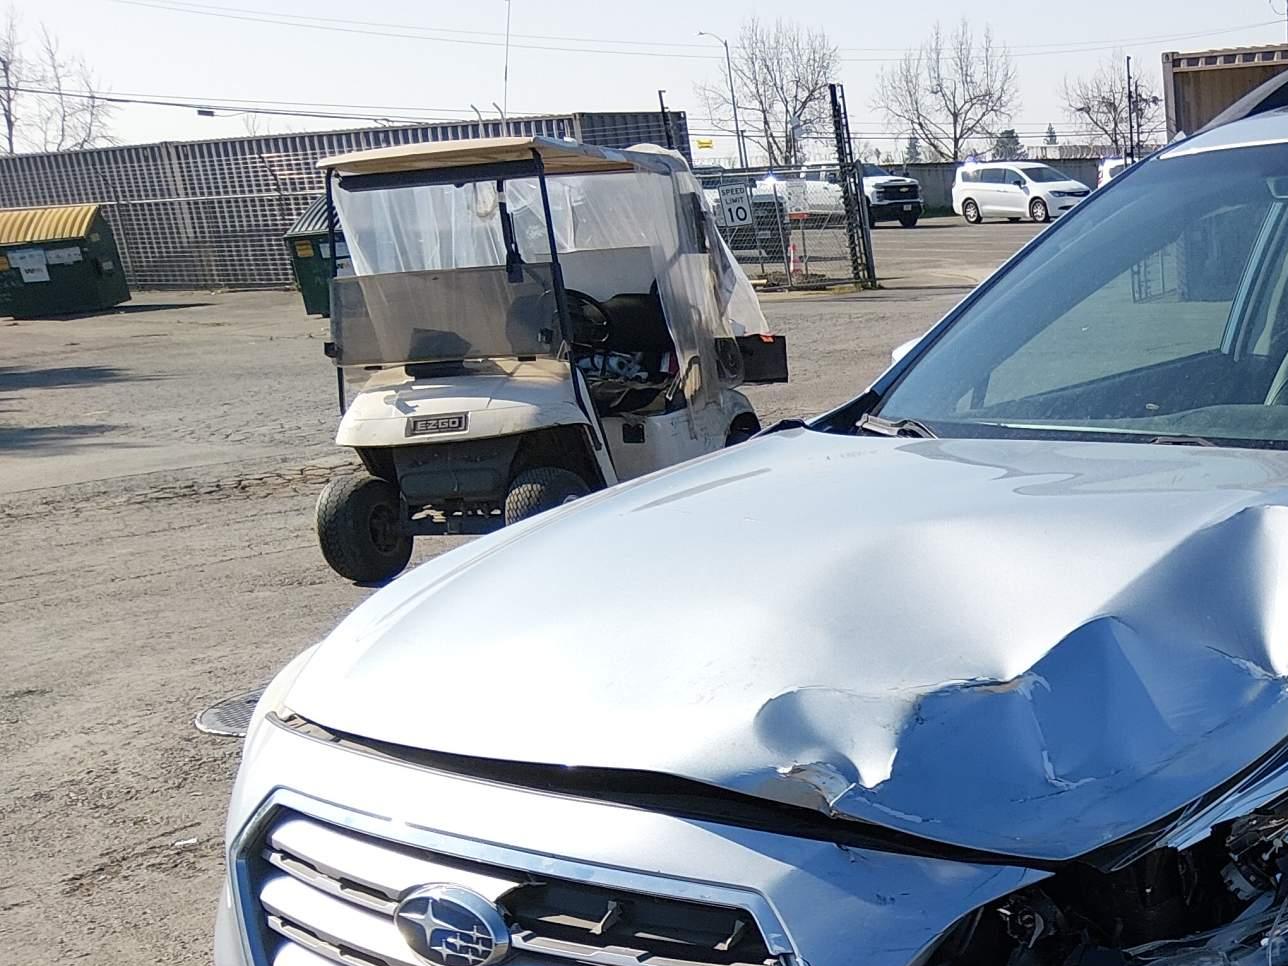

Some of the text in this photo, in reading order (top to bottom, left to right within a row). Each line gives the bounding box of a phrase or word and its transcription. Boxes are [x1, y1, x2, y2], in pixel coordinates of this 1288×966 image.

[721, 187, 745, 196] SPEED
[725, 196, 744, 205] LIMIT
[728, 206, 748, 223] 10
